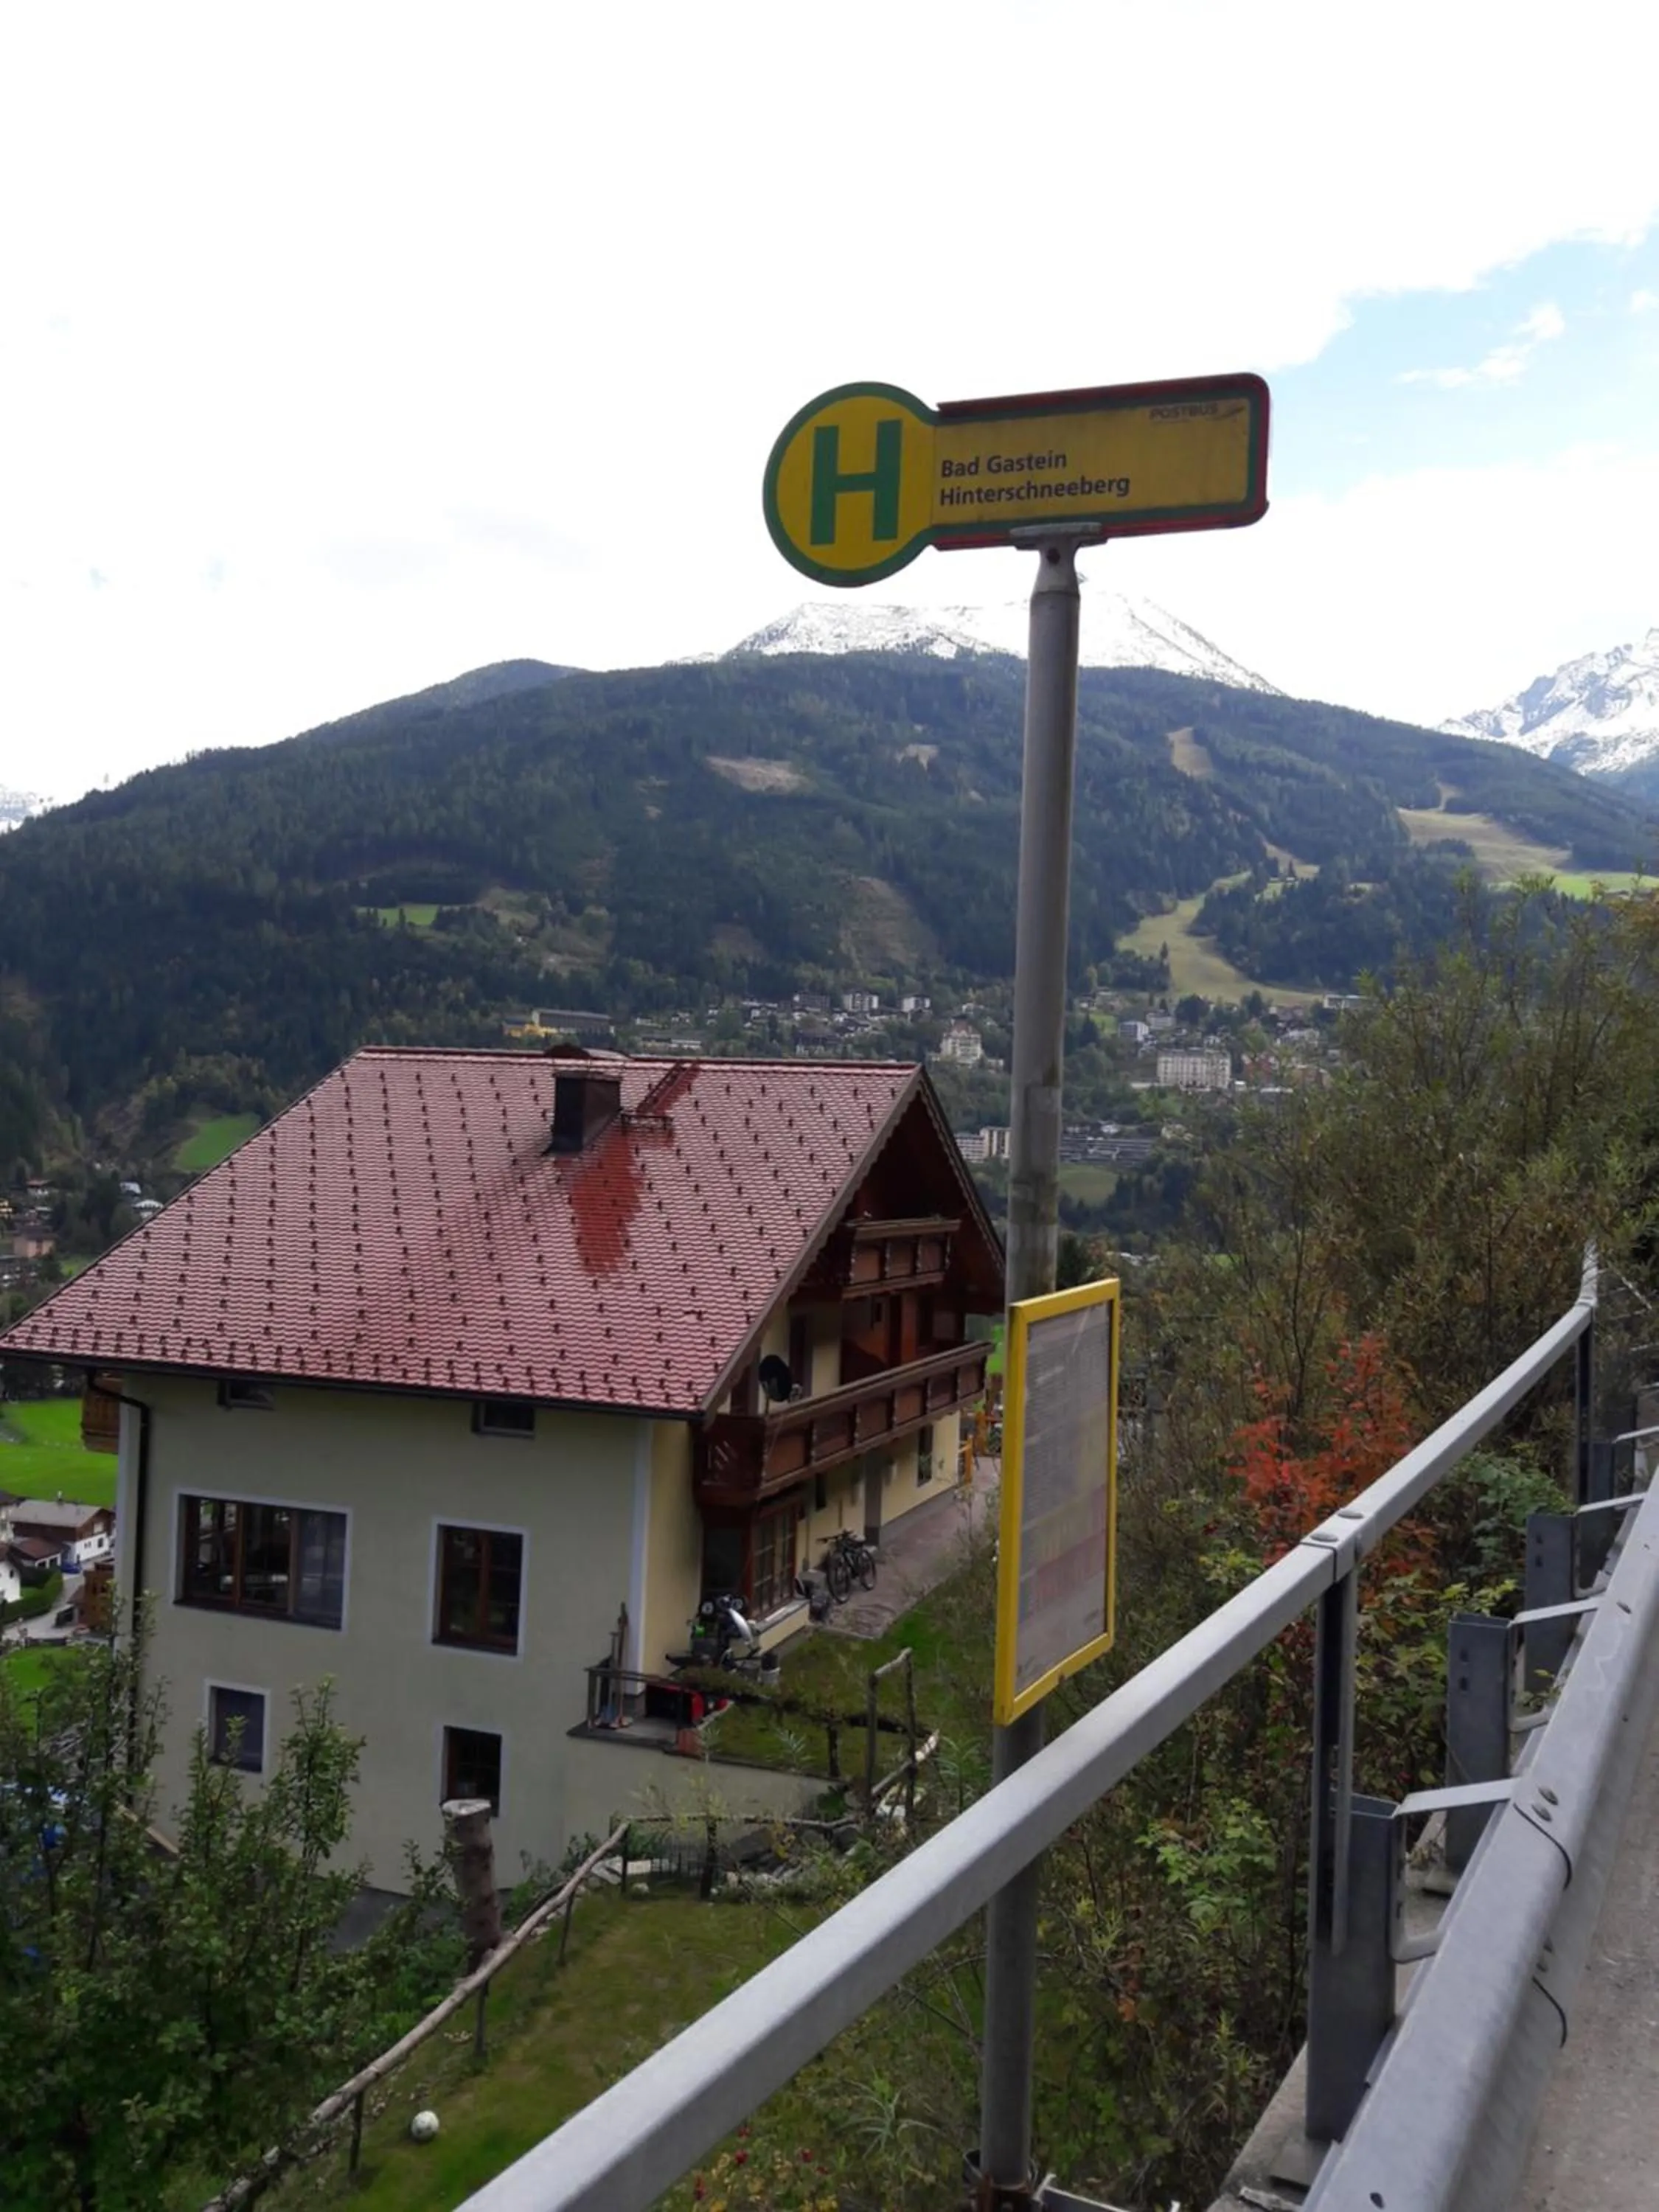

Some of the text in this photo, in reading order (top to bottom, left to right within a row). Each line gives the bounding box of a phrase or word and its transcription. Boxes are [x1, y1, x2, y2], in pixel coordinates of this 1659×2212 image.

[1149, 402, 1219, 420] POSTBUS
[941, 450, 1067, 478] Bad Gastein
[809, 419, 902, 546] H
[939, 475, 1130, 507] Hinterschneeberg
